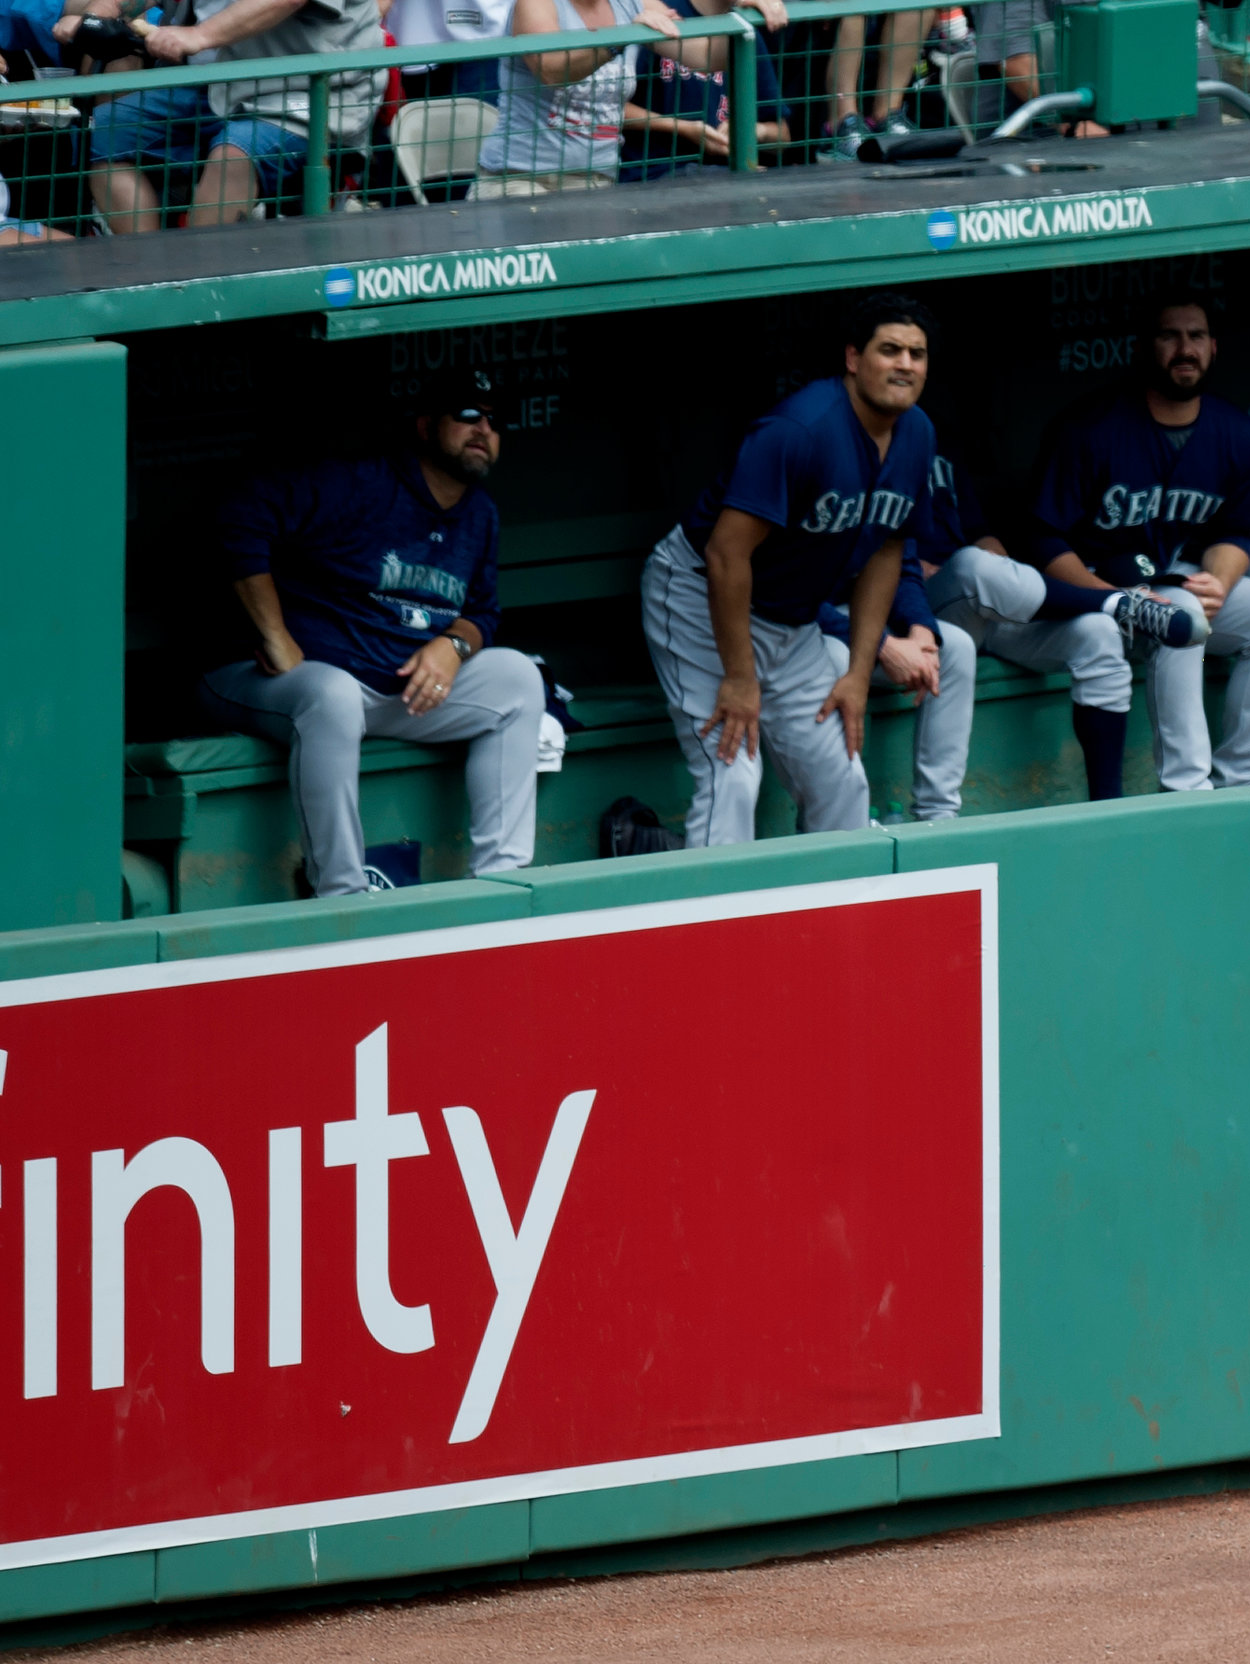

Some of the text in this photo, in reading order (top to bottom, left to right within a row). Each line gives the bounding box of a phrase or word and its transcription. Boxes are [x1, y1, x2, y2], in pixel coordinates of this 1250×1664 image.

[958, 196, 1153, 243] KONICA MINOLTA
[357, 251, 557, 300] KONICA MINOLTA
[0, 1021, 598, 1444] inity
